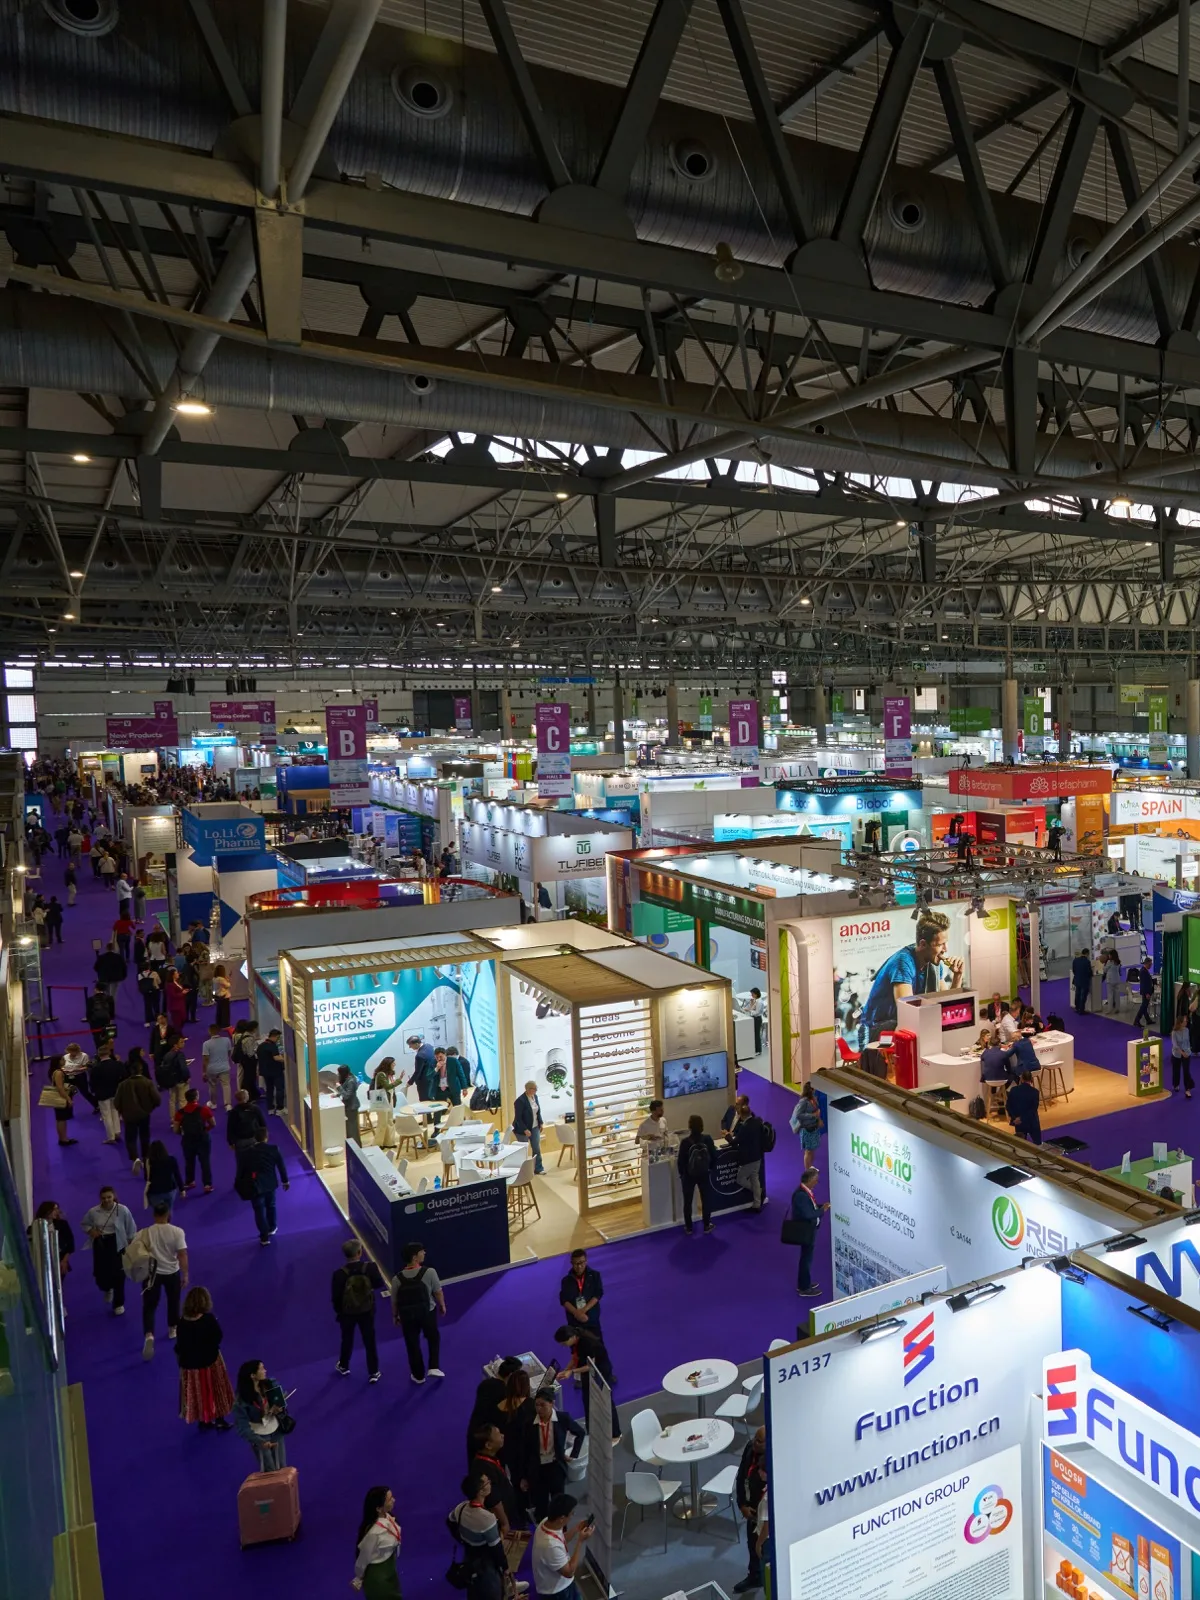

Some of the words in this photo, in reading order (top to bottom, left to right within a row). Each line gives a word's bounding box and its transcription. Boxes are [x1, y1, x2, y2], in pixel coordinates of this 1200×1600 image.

[263, 711, 271, 722] C
[367, 709, 374, 721] D
[460, 707, 466, 718] F
[1154, 711, 1162, 730] H
[738, 721, 750, 743] D
[893, 715, 903, 737] F
[1030, 714, 1039, 733] G
[339, 729, 356, 757] B
[546, 725, 560, 751] C
[830, 755, 853, 768] ITALIA
[764, 765, 814, 779] ITALIA
[971, 780, 1002, 791] Brefapharm
[1052, 779, 1098, 791] Brefapharm
[856, 797, 894, 810] Biobor
[1141, 799, 1183, 816] SPAIN
[205, 830, 236, 839] Lo.Li.
[215, 838, 261, 848] Pharma
[839, 919, 891, 937] anona
[313, 995, 387, 1013] NGINEERING
[314, 1008, 376, 1024] TURNKEY
[590, 1012, 620, 1024] Ideas
[314, 1019, 374, 1035] OLUTIONS
[592, 1029, 636, 1042] Become
[334, 1036, 358, 1044] Sciences
[592, 1045, 641, 1060] Products
[427, 1187, 500, 1209] duepipharma
[850, 1184, 884, 1210] GUANGZHOU
[883, 1202, 916, 1228] HARWORLD
[853, 1198, 864, 1211] LIFE
[865, 1205, 892, 1227] SCIENCES
[903, 1227, 915, 1240] LTD
[956, 1230, 972, 1246] 3A144
[836, 1314, 862, 1328] RISUN
[777, 1352, 832, 1384] 3A137
[855, 1376, 980, 1441] Function
[814, 1415, 1001, 1506] www.function.cn
[1054, 1458, 1083, 1487] DOLOSH
[1051, 1479, 1062, 1491] TOP
[1061, 1486, 1081, 1506] SELLER
[852, 1496, 922, 1540] FUNCTION
[924, 1475, 971, 1506] GROUP
[1051, 1487, 1062, 1499] PET
[1083, 1509, 1101, 1530] BRAND
